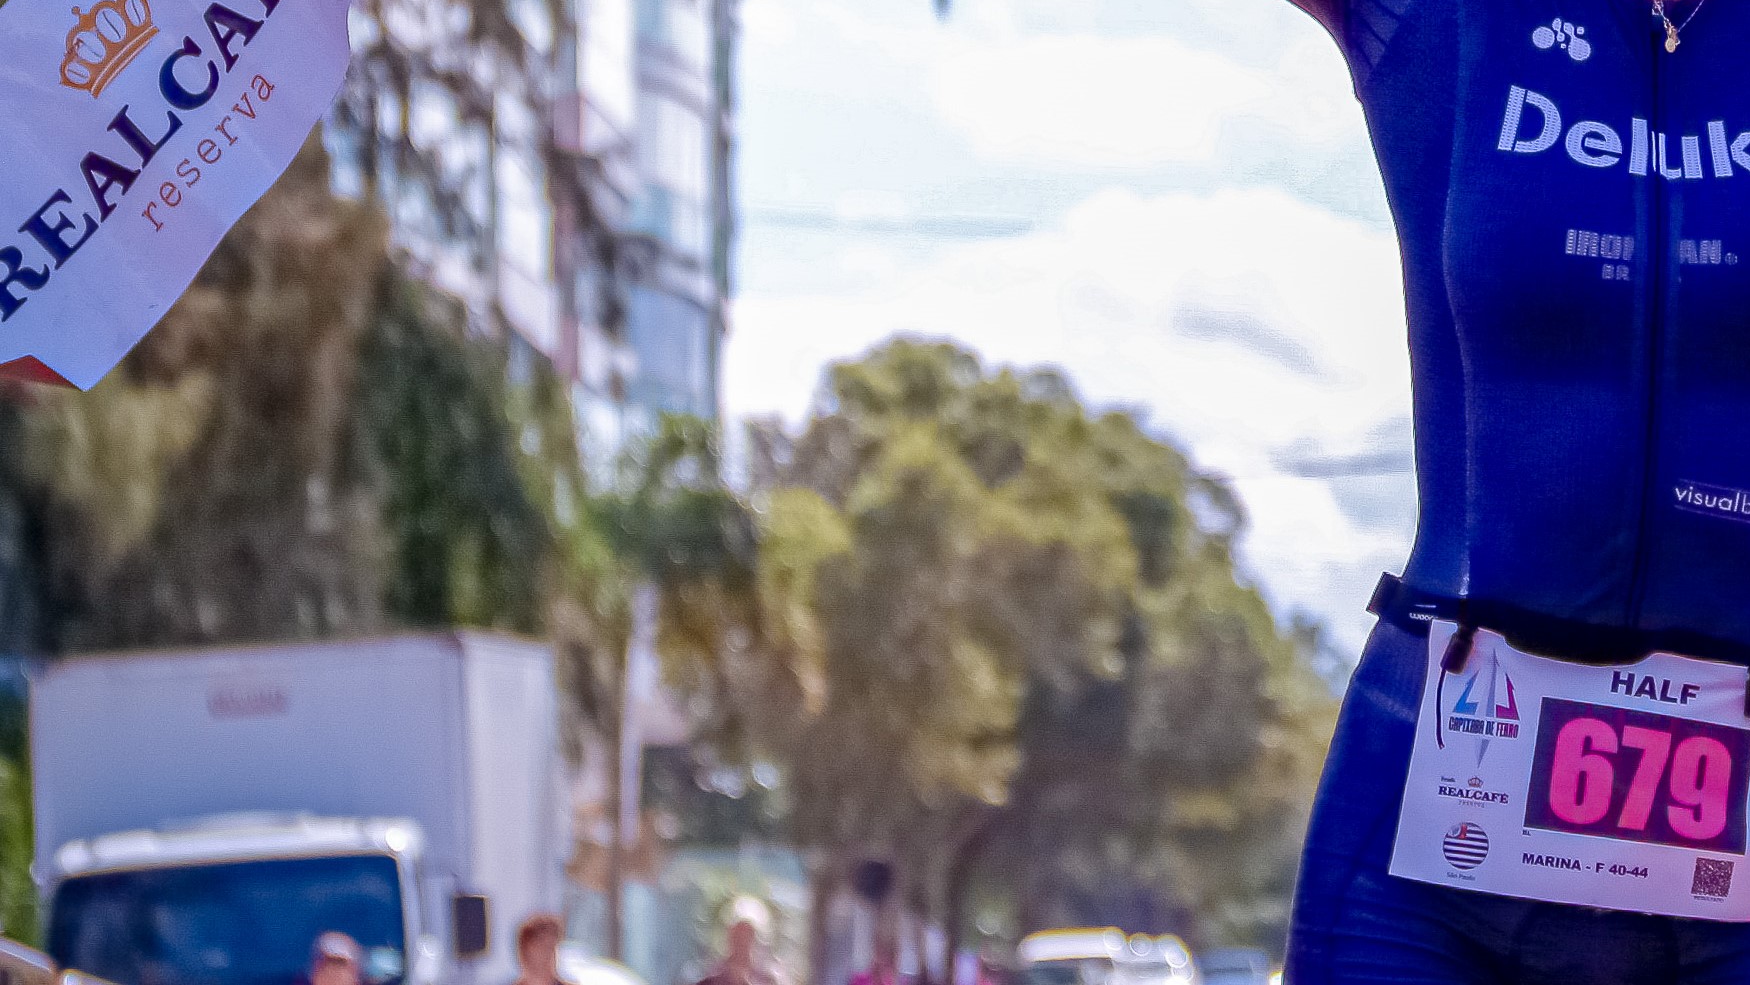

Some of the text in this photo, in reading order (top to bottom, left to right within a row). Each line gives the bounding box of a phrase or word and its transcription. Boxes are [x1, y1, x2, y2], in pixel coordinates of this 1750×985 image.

[141, 71, 276, 233] reserva
[1565, 229, 1722, 265] IRONAN
[1610, 670, 1700, 706] HALF
[1438, 785, 1509, 804] REALCAFÉ
[1549, 717, 1732, 841] 679
[1522, 852, 1582, 872] MARINA
[1595, 862, 1605, 874] F
[1608, 863, 1649, 879] 40-44
